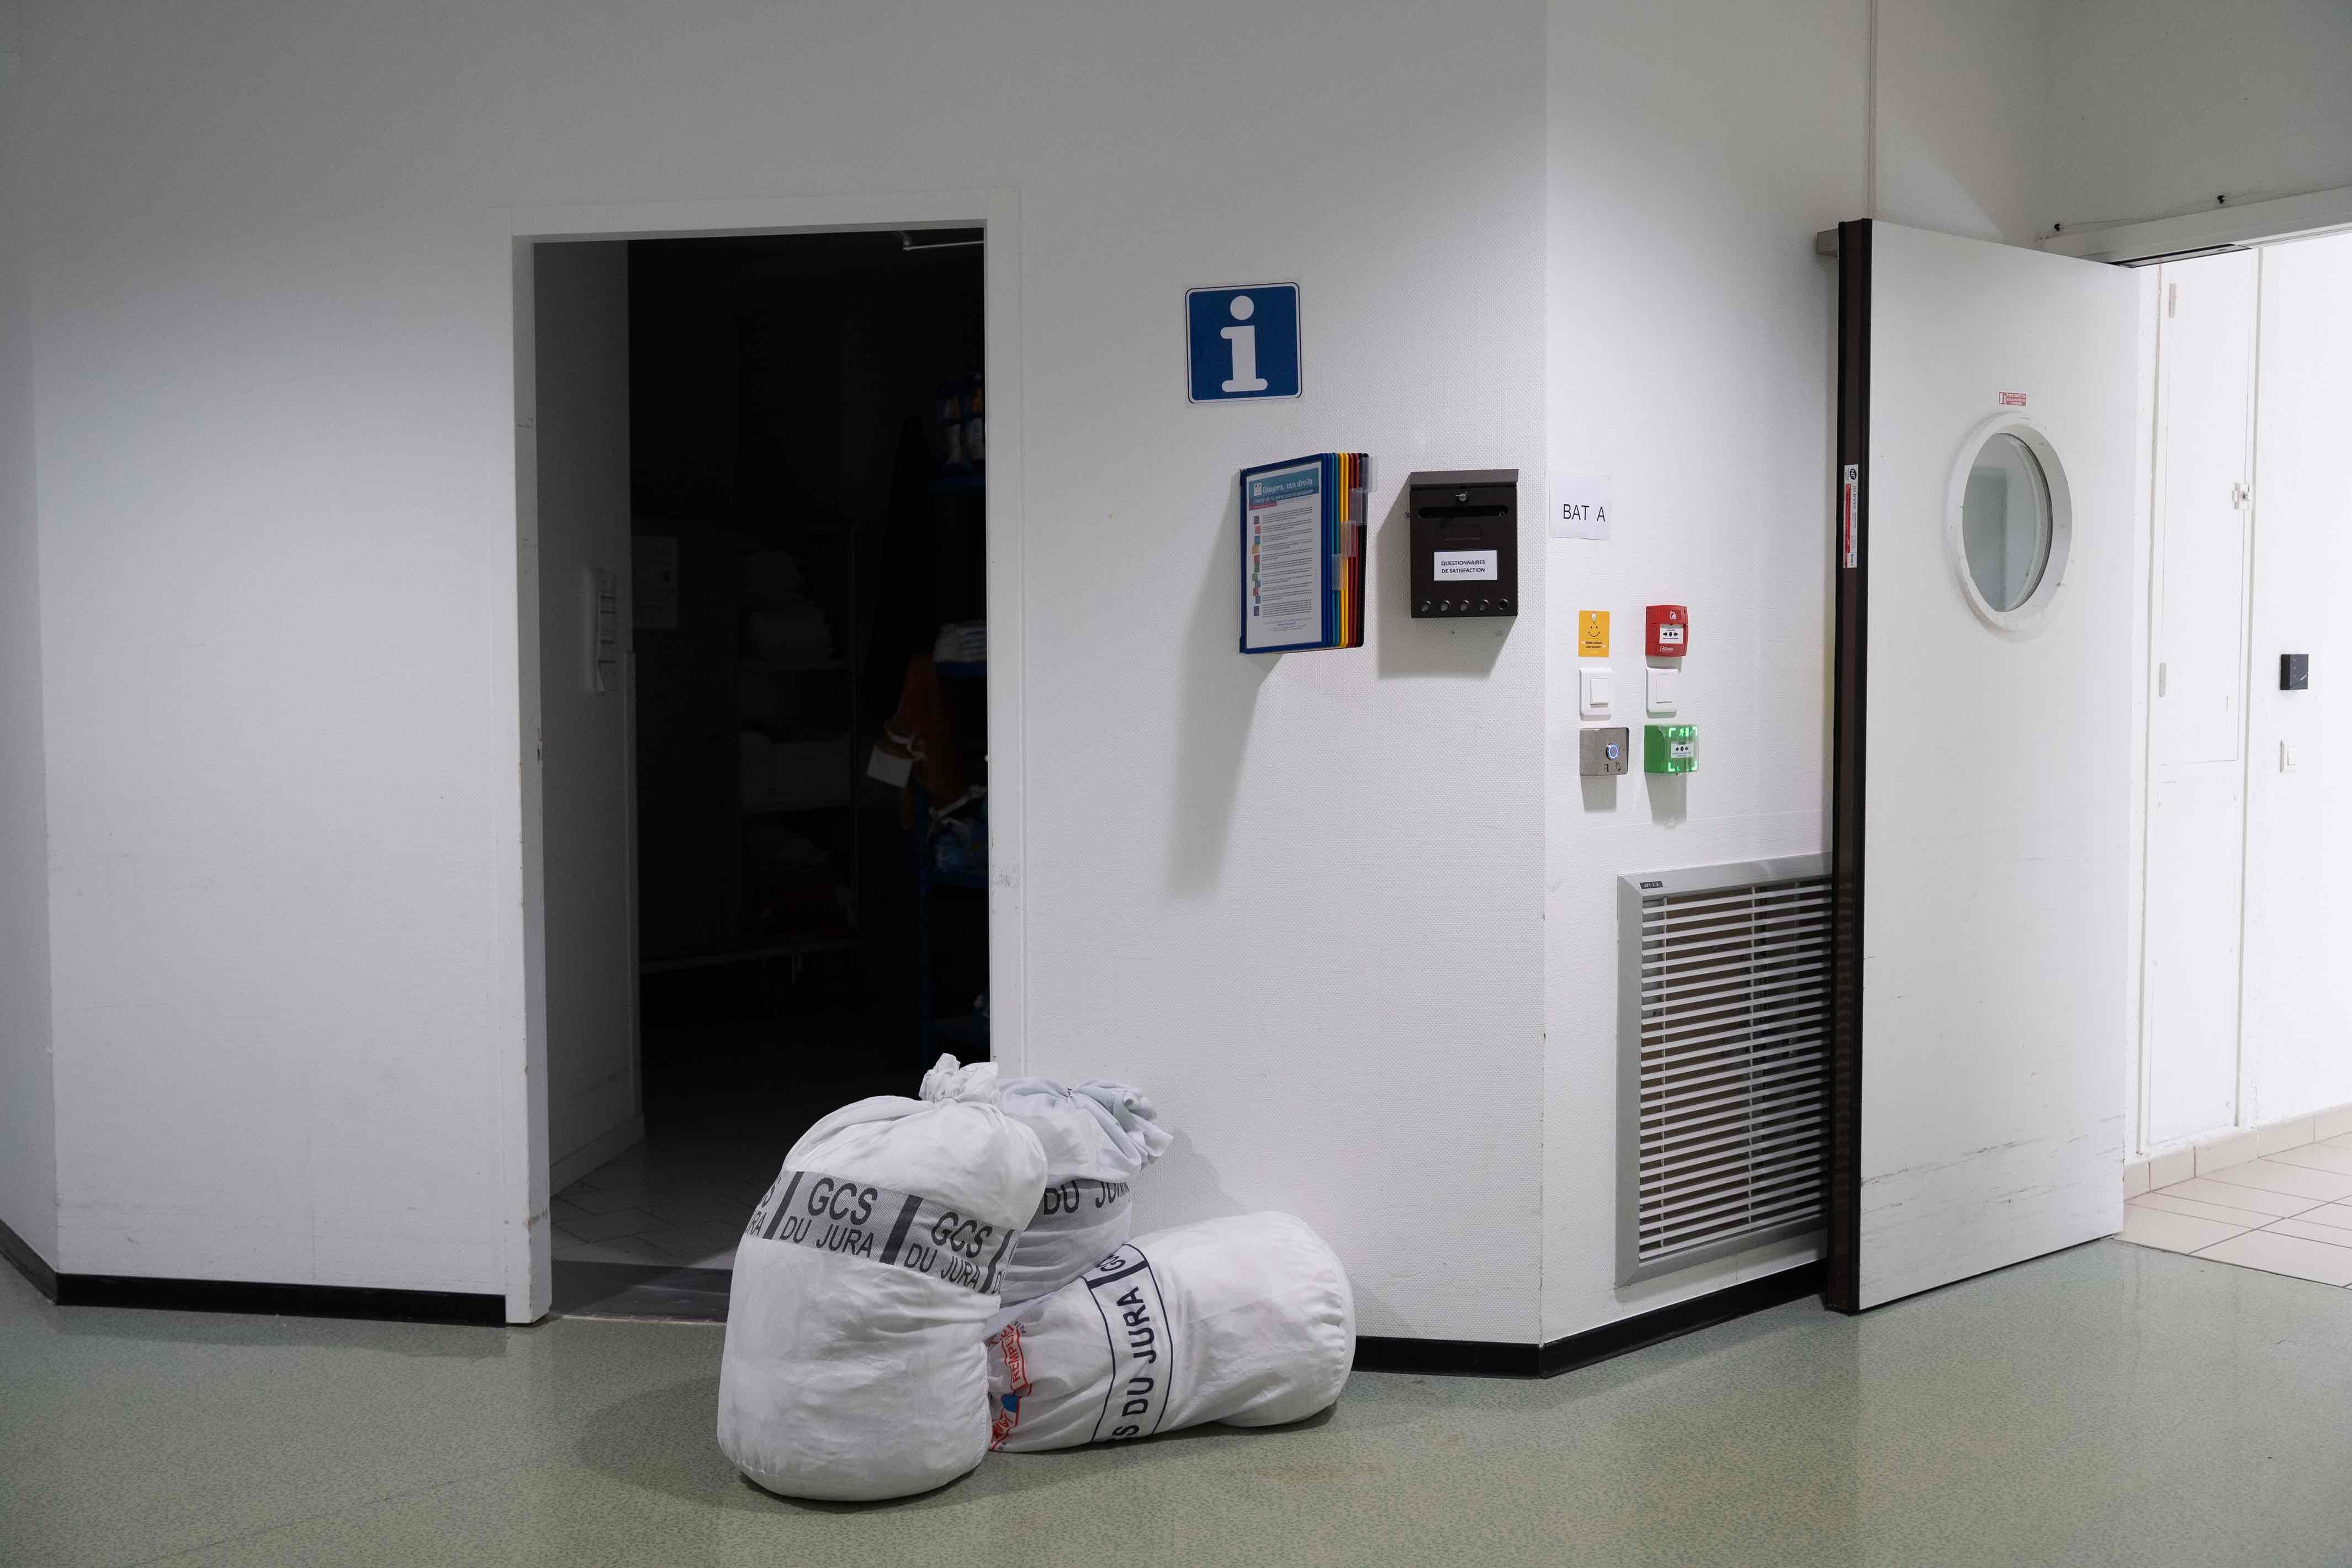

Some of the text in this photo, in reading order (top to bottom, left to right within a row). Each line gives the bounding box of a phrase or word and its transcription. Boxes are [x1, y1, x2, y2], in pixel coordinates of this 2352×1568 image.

[1564, 504, 1605, 521] BAT A
[808, 1177, 878, 1226] GCS
[1042, 1180, 1079, 1215] DU
[744, 1211, 767, 1236] RA
[780, 1216, 874, 1258] DU JURA
[931, 1211, 993, 1258] GCS
[904, 1243, 981, 1289] DU JURA
[1116, 1286, 1157, 1364] JURA
[1121, 1378, 1154, 1417] DU
